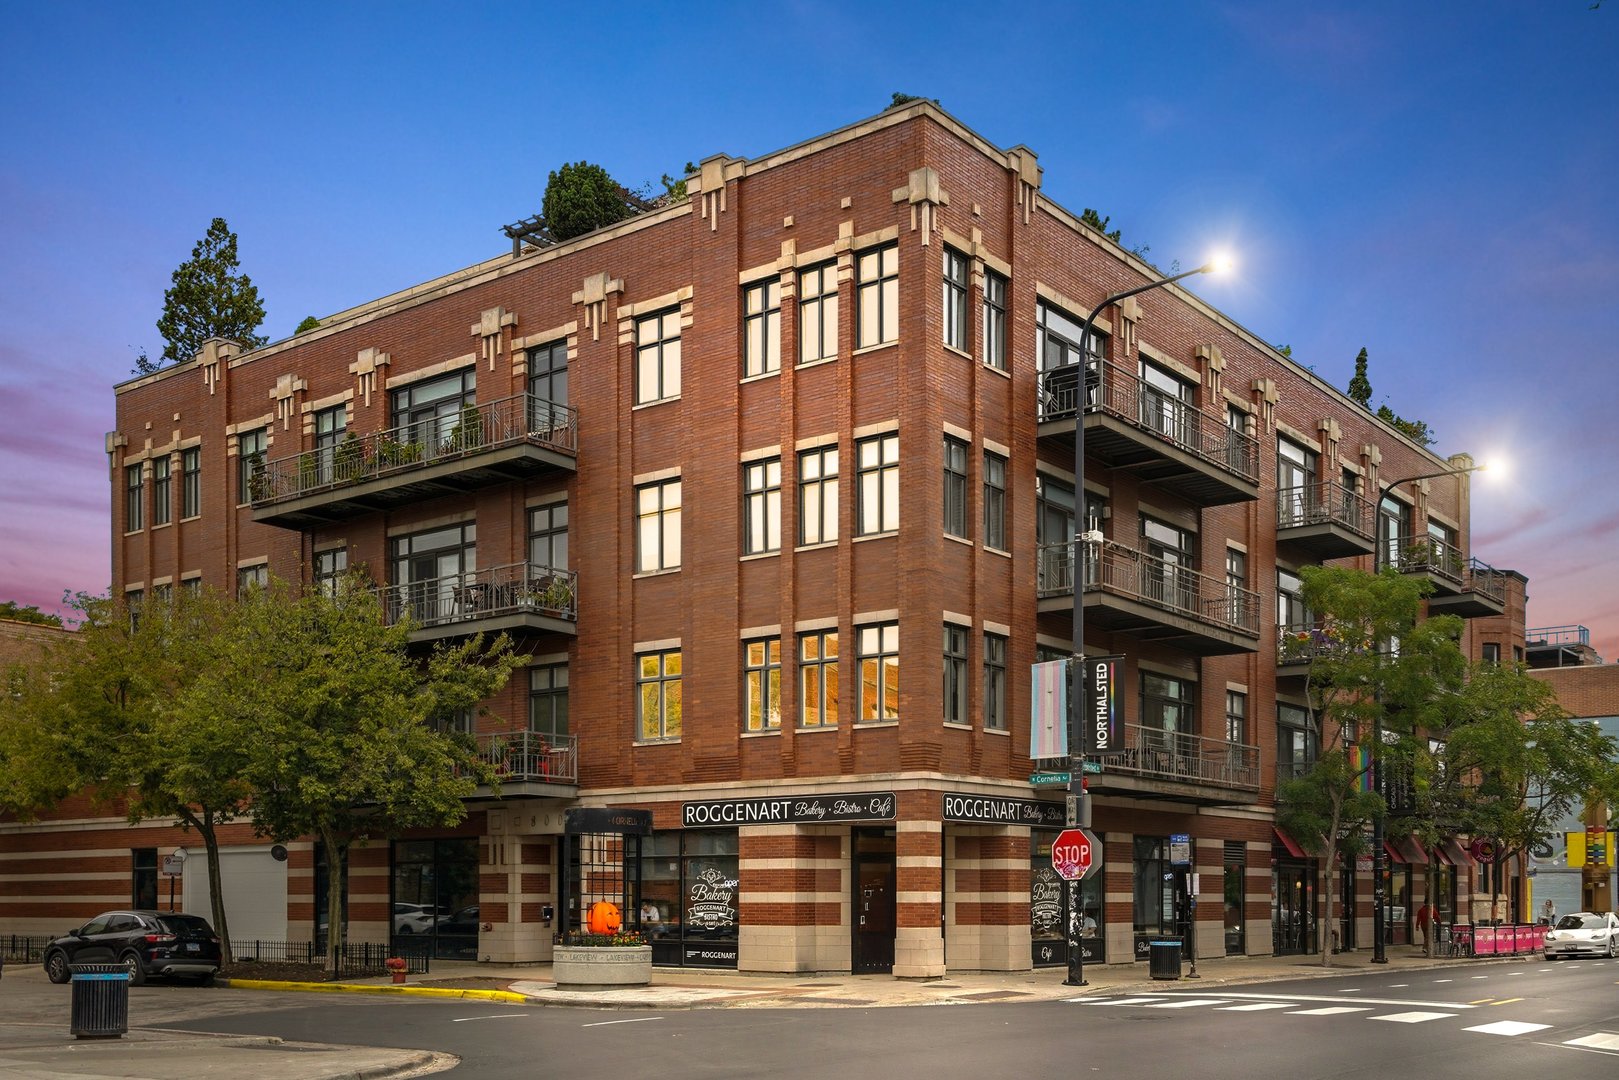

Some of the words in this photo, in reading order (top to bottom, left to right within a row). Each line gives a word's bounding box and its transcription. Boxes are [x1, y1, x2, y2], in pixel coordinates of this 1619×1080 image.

[1096, 662, 1108, 749] NORTHALSTED
[1036, 775, 1061, 783] Cornelia
[686, 801, 791, 823] ROGGENART
[794, 800, 827, 819] Bakery
[833, 799, 862, 815] Bistro
[869, 796, 892, 817] Café
[945, 797, 1022, 820] ROGGENART
[1023, 805, 1044, 824] Bakery
[1054, 845, 1089, 865] STOP
[691, 884, 733, 905] Bakery
[1033, 883, 1061, 904] Bakery
[696, 904, 727, 912] ROGGENART
[701, 951, 737, 959] ROGGENART
